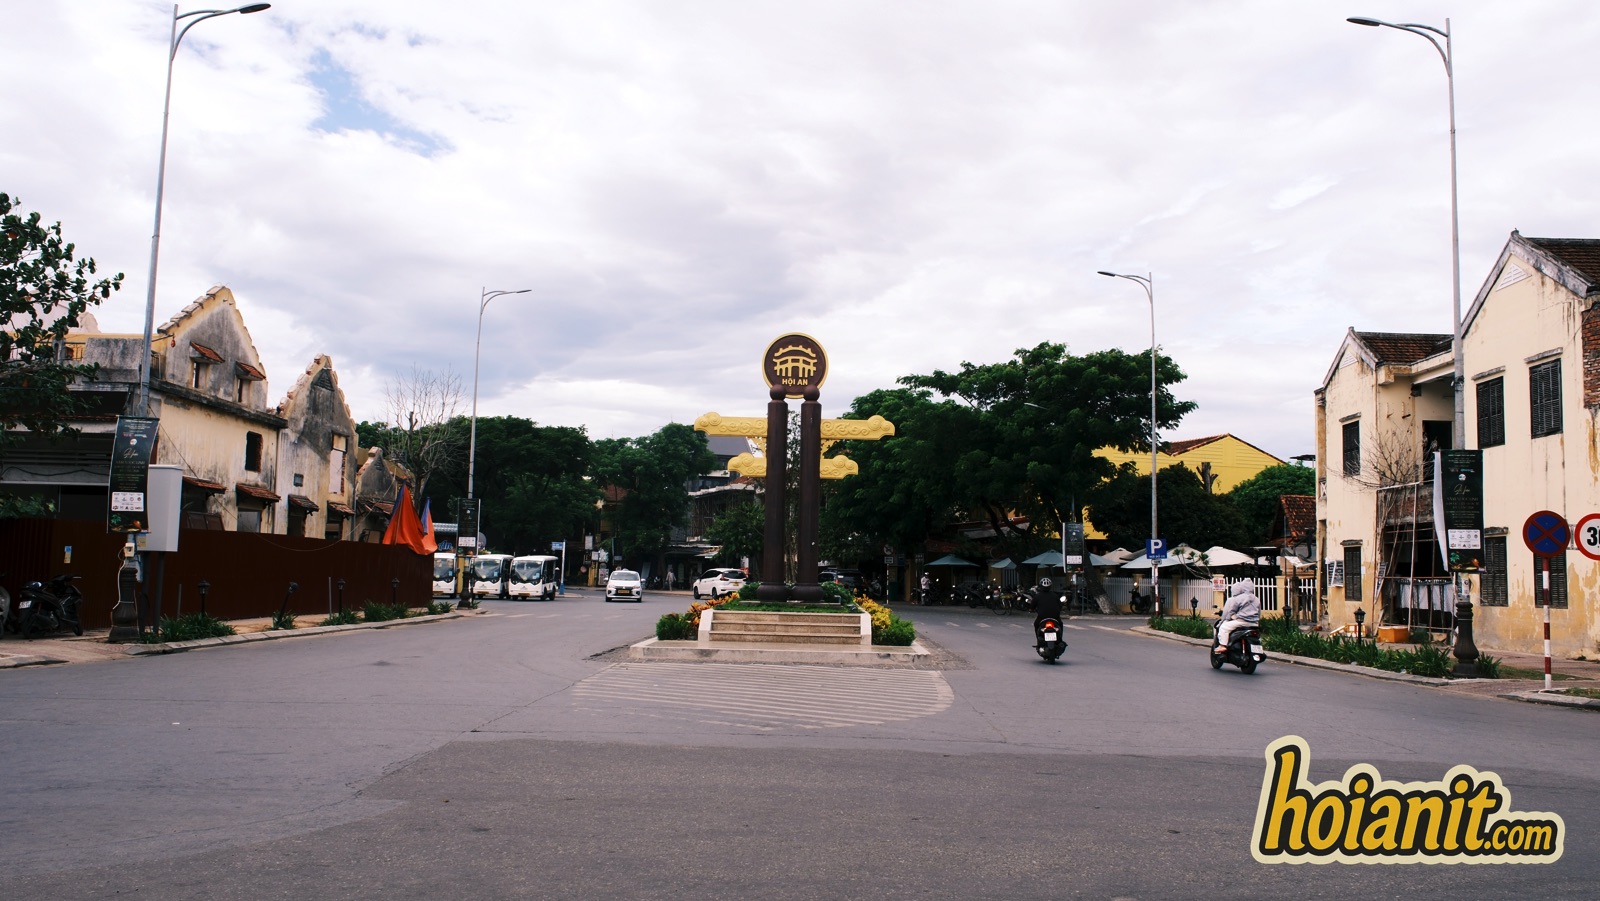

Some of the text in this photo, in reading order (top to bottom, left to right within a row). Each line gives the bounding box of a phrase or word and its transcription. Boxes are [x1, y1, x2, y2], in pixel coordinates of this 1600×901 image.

[782, 378, 796, 386] HỘI
[1587, 526, 1600, 546] 3
[1151, 540, 1163, 554] P
